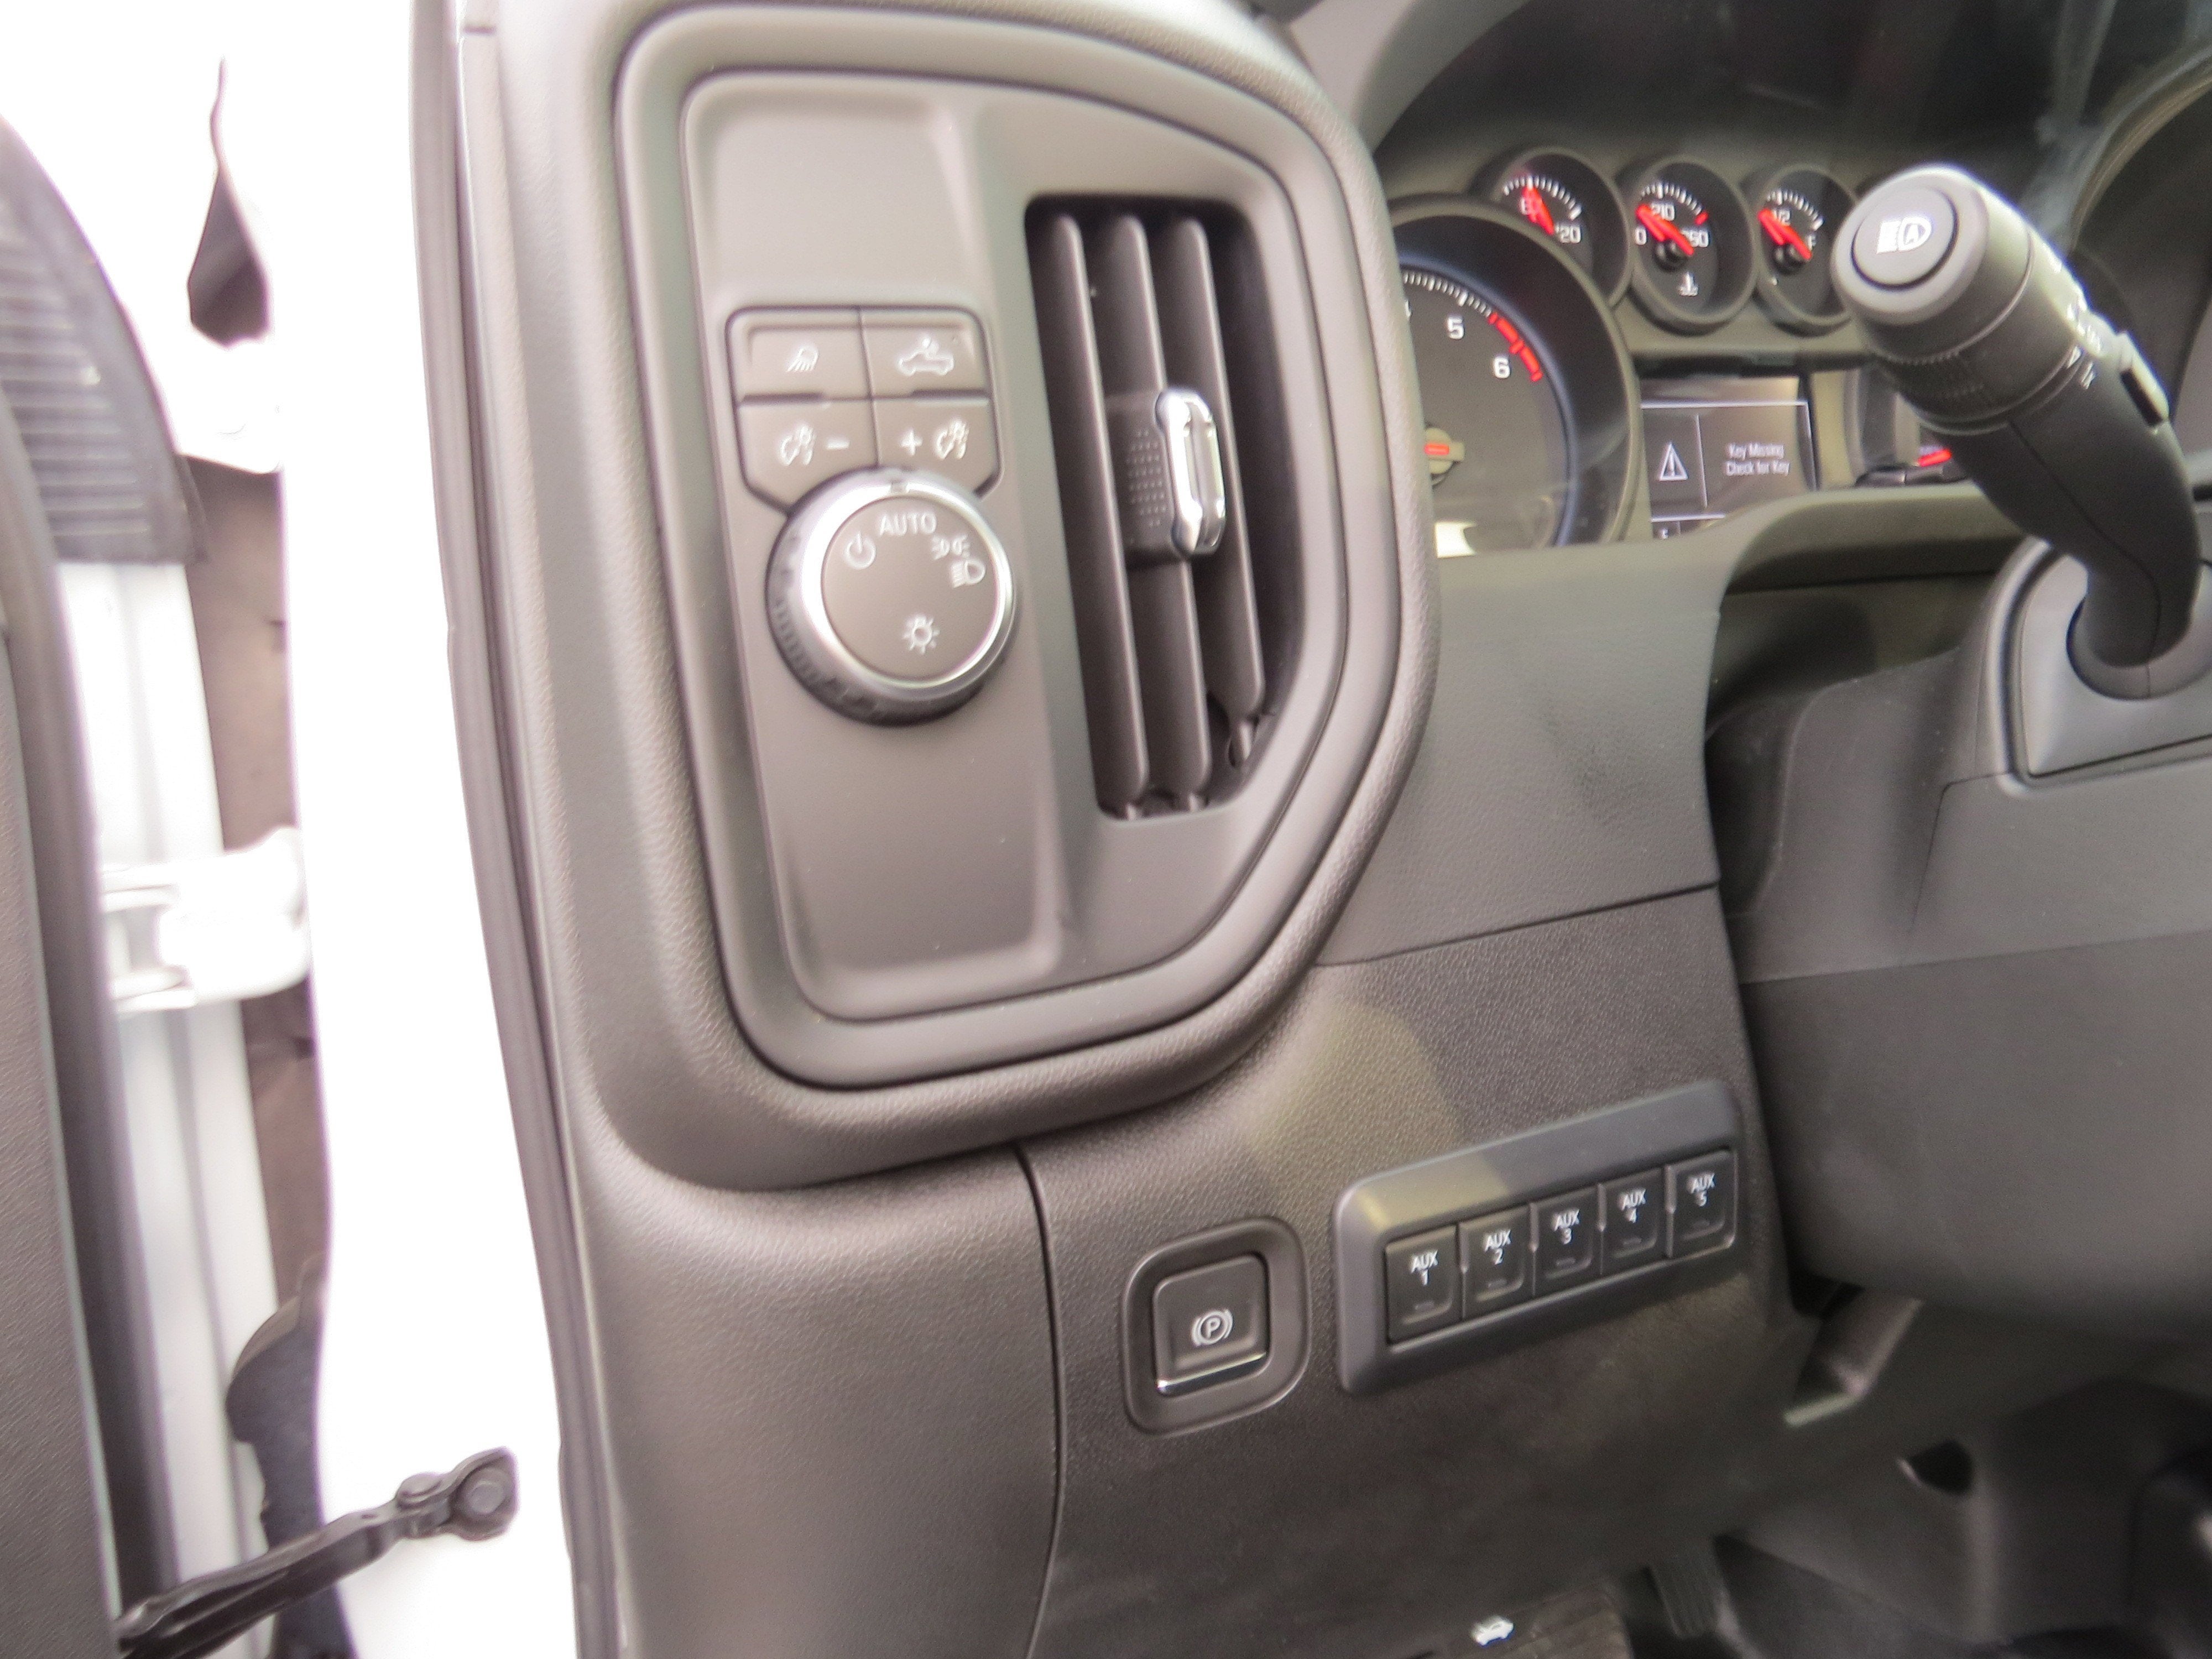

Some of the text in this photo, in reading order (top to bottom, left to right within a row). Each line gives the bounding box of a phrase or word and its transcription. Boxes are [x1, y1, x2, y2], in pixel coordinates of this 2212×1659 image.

[1447, 315, 1465, 340] 5
[1493, 354, 1511, 379] 6
[878, 512, 938, 537] AUTO
[1687, 1172, 1715, 1194] AUX
[1619, 1189, 1646, 1211] AUX
[1697, 1191, 1707, 1207] 5
[1552, 1209, 1580, 1232] AUX
[1483, 1229, 1511, 1253] AUX
[1561, 1227, 1572, 1245] 3
[1411, 1250, 1438, 1274] AUX
[1494, 1248, 1504, 1265] 2
[1420, 1269, 1429, 1286] 1
